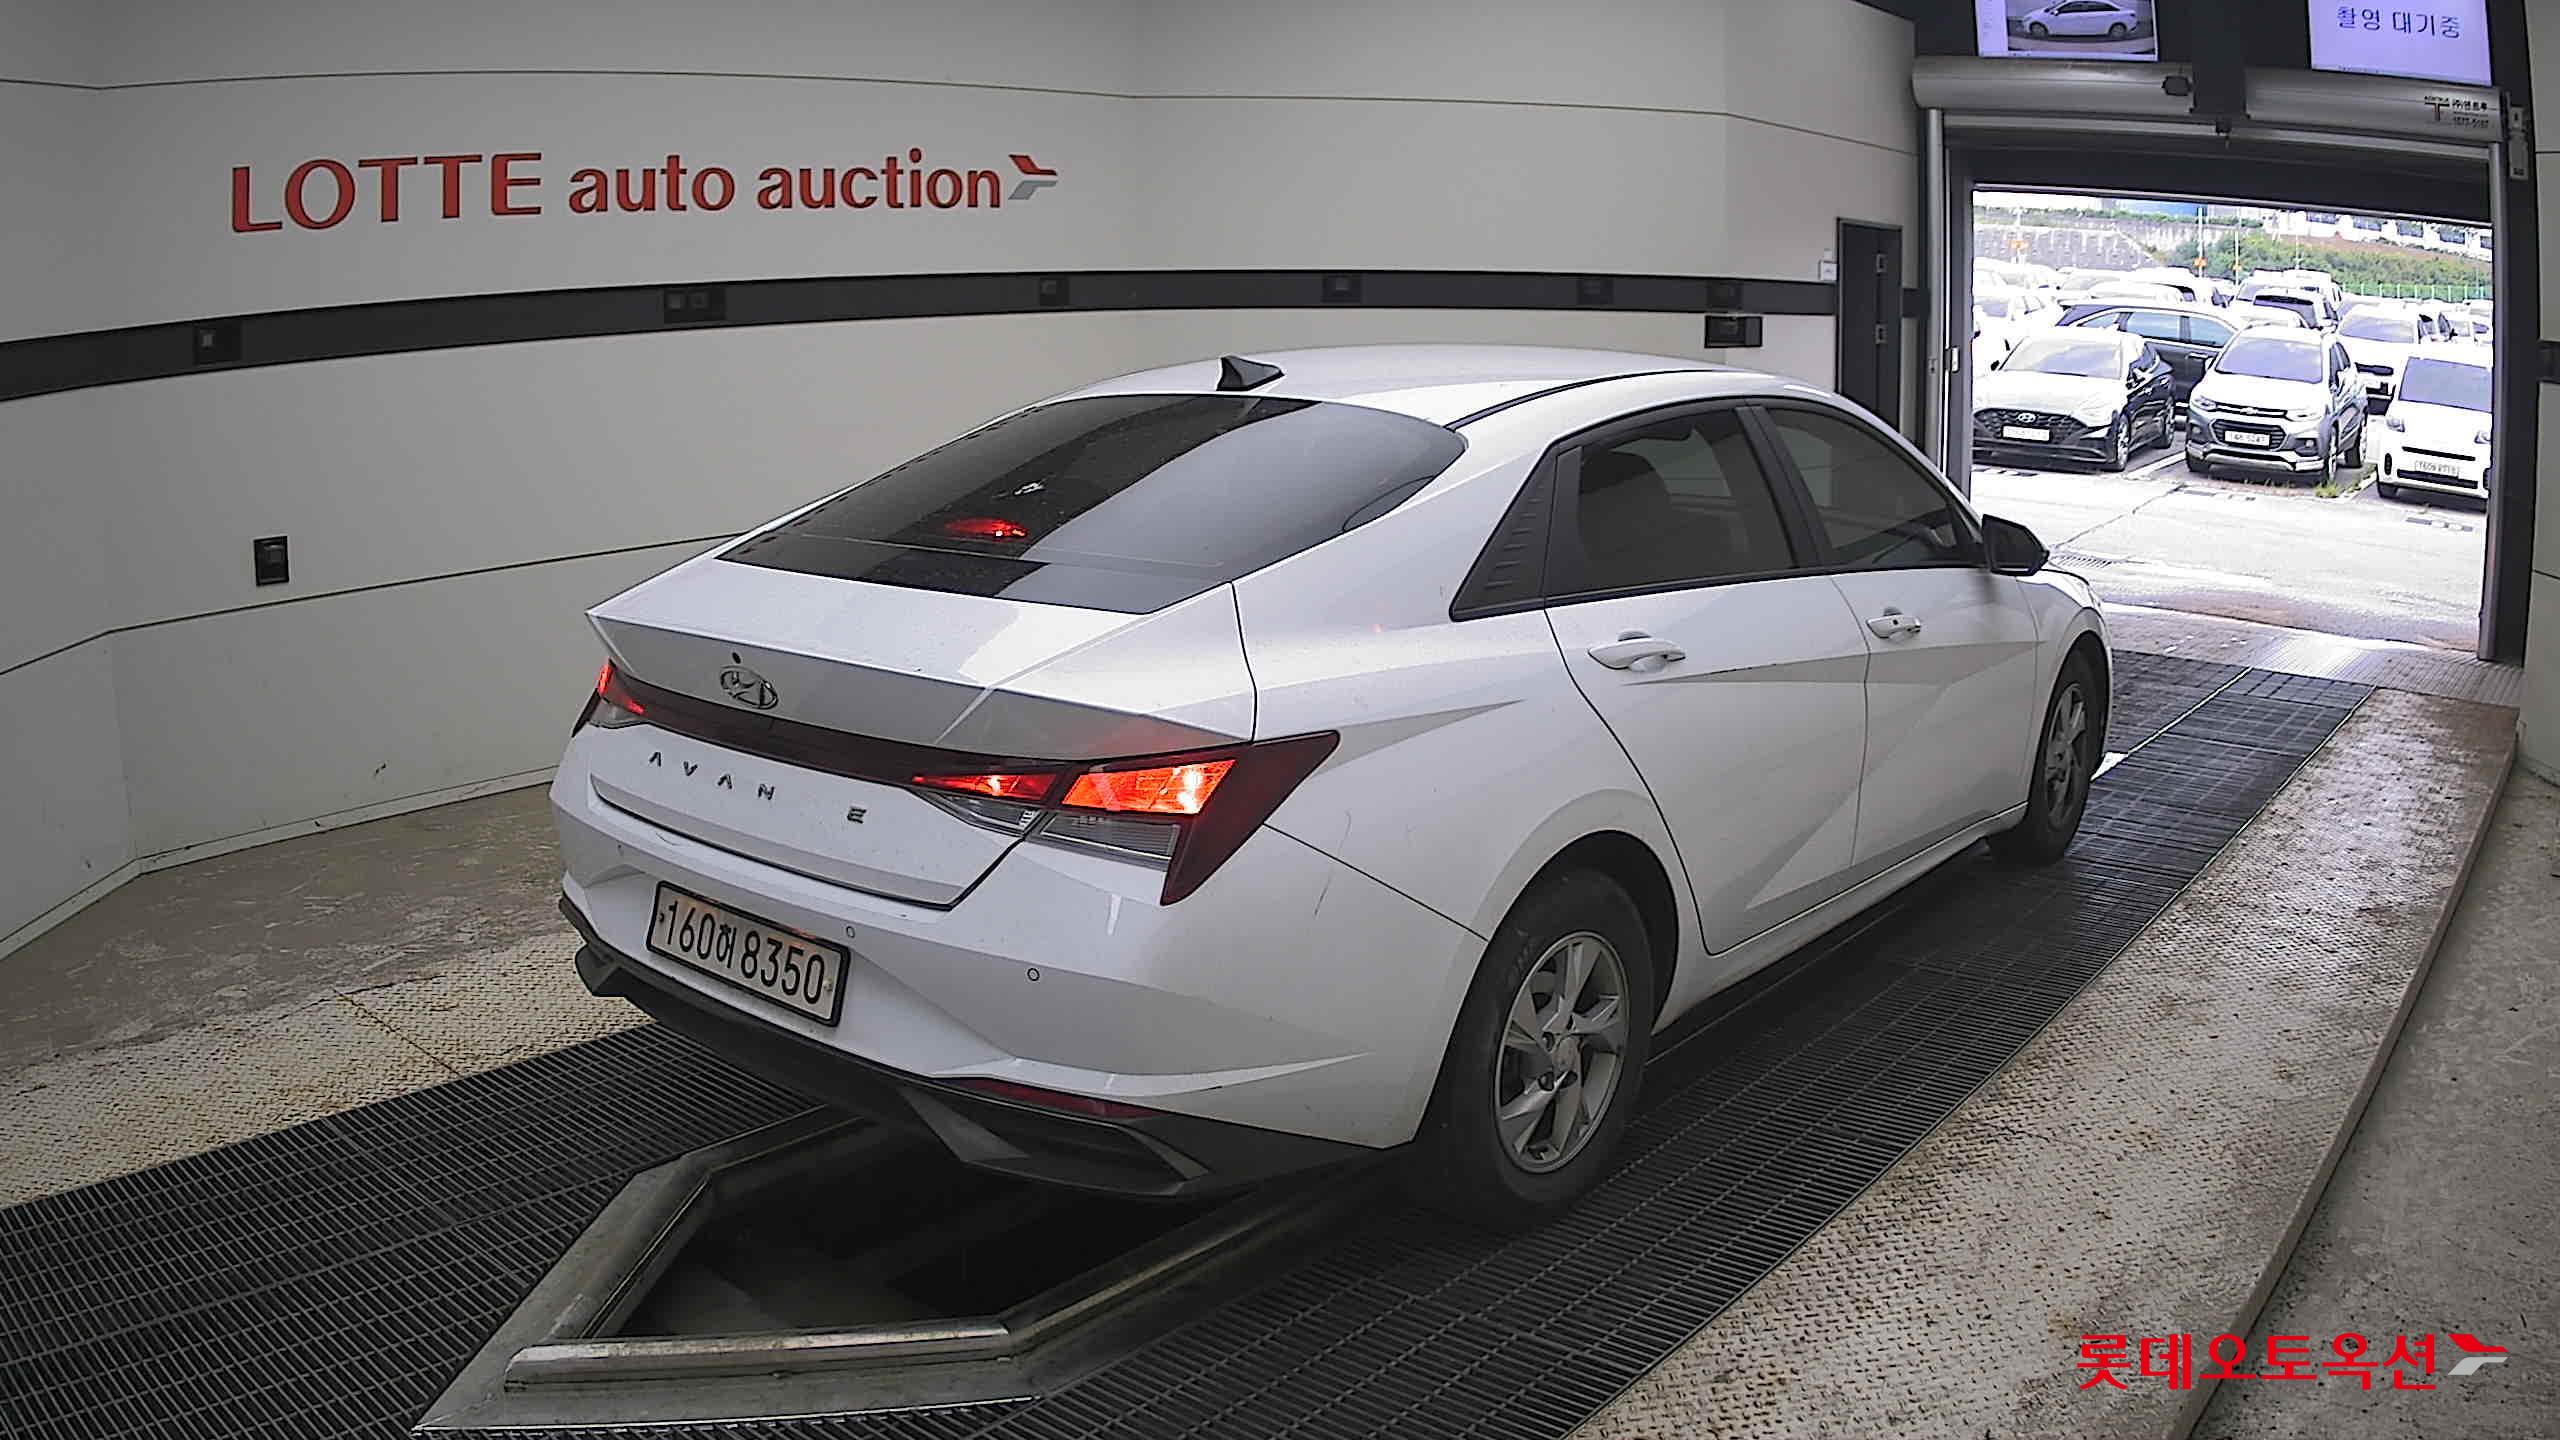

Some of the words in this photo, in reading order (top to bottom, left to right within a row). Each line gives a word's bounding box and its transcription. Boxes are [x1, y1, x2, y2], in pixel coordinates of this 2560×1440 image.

[2337, 6, 2382, 31] 촬영
[2391, 11, 2461, 39] 대기중
[231, 153, 542, 233] LOTTE
[568, 155, 735, 213] auto
[757, 148, 1002, 209] auction
